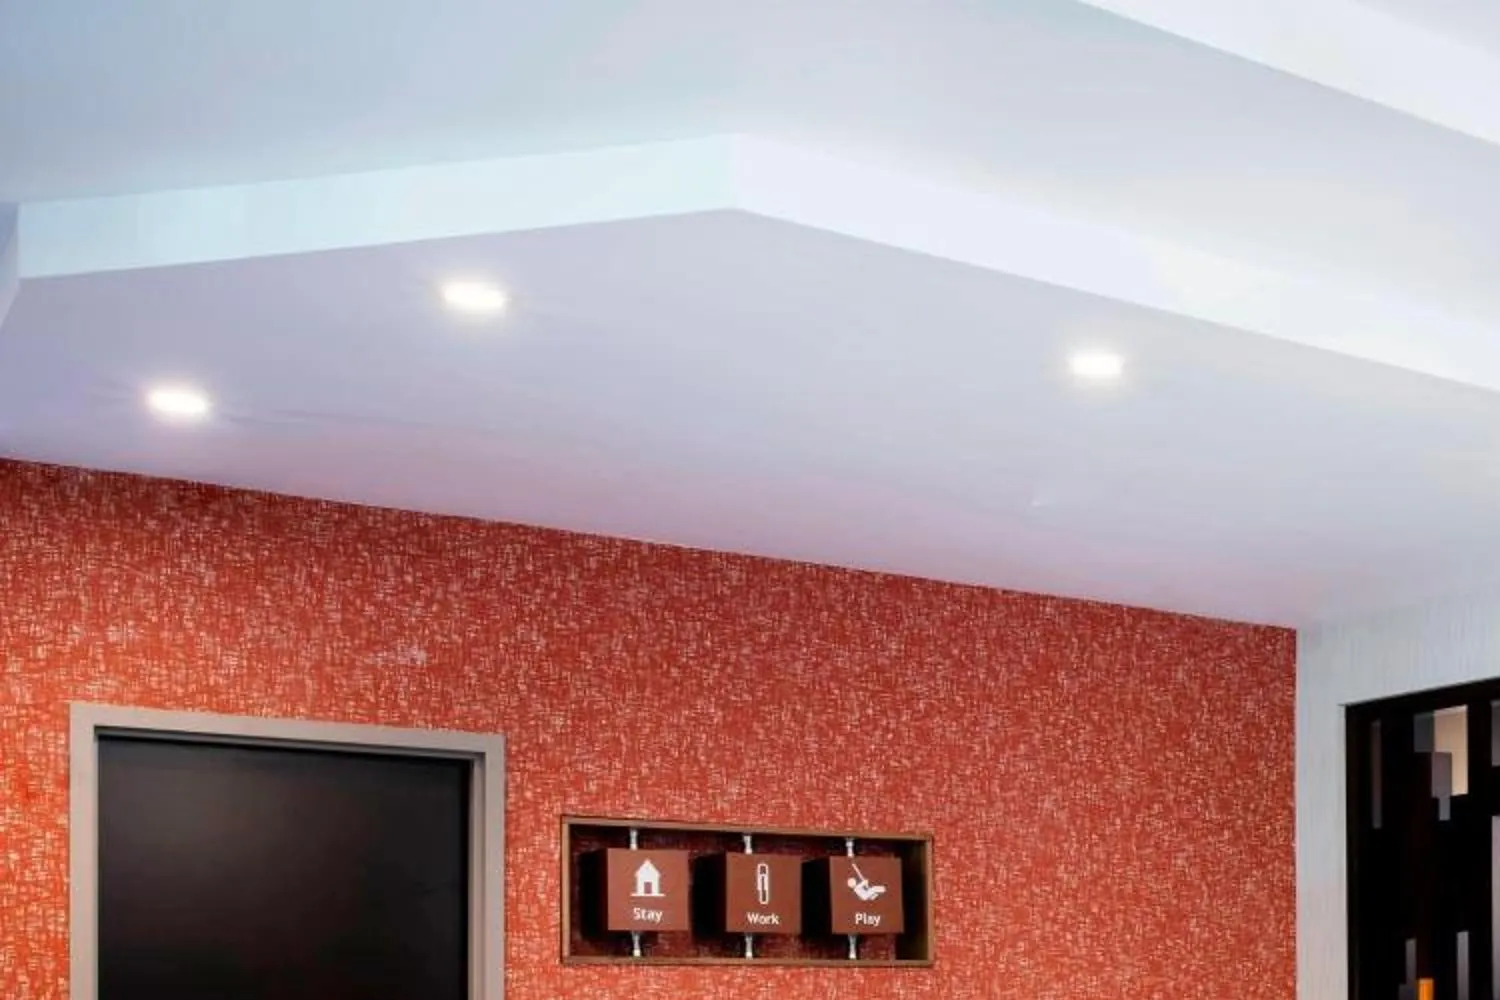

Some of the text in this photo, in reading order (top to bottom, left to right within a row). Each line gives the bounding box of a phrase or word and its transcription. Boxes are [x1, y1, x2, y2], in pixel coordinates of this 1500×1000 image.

[633, 907, 663, 923] Stay
[746, 912, 780, 924] Work
[855, 912, 881, 926] Play
